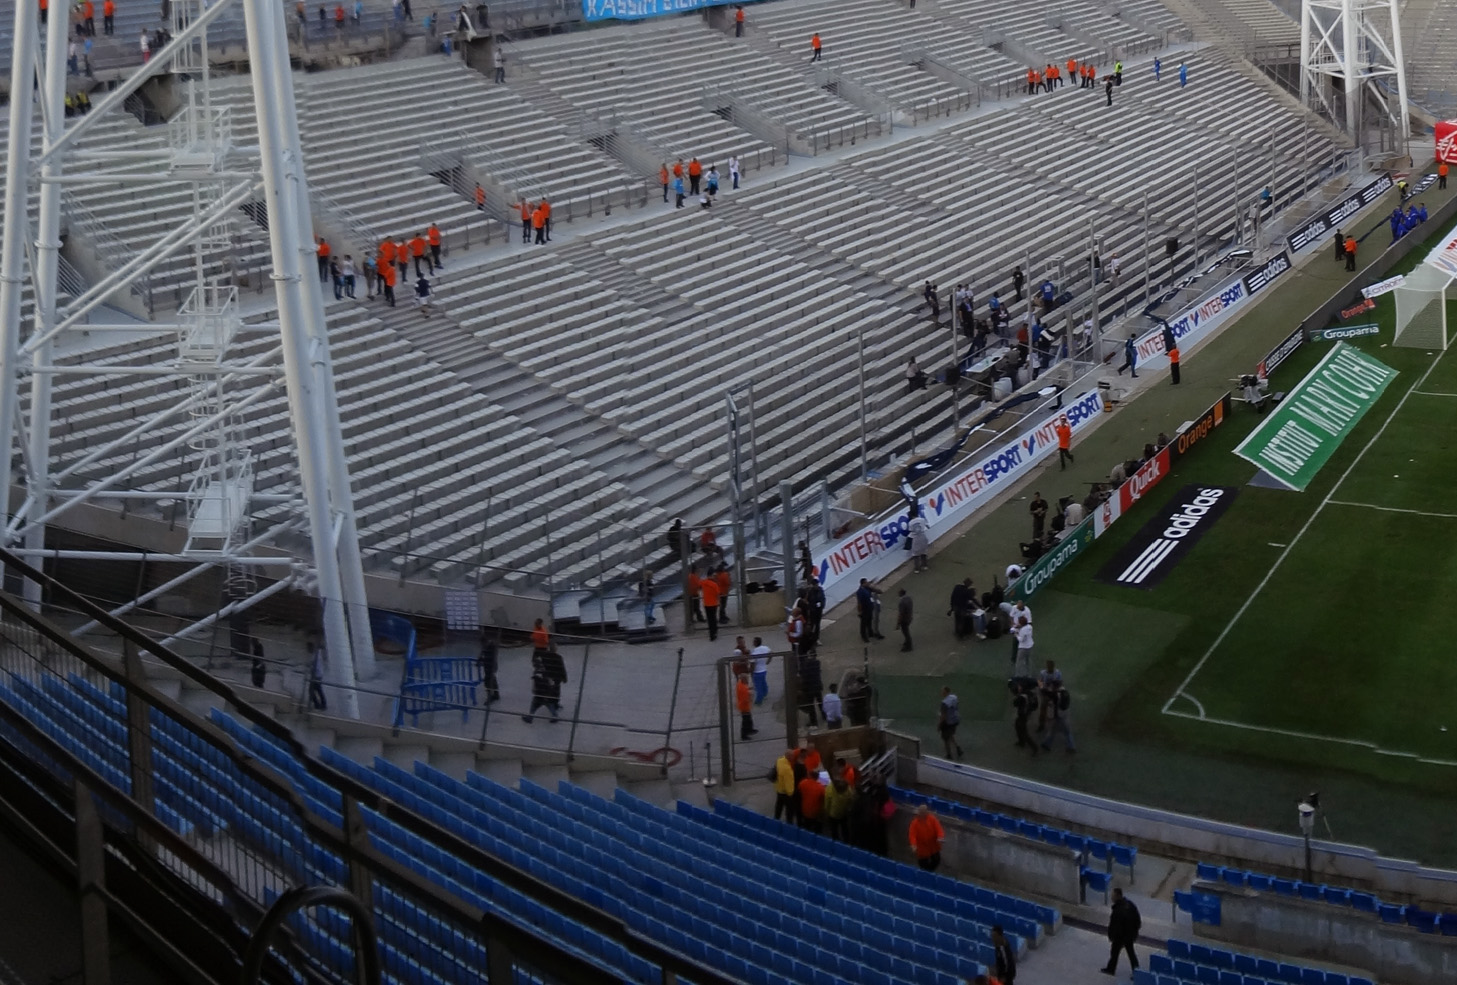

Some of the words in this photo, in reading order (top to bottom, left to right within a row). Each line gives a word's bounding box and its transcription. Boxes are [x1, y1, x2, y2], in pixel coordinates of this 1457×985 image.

[1340, 198, 1360, 218] adidas
[1305, 219, 1326, 241] adidas
[1262, 256, 1287, 281] adidas
[1199, 283, 1245, 323] INTERSPORT
[1323, 325, 1380, 340] Groupama
[1289, 378, 1361, 437] MARY
[1177, 415, 1214, 455] Orange
[1259, 420, 1323, 476] INSTITUT
[944, 445, 1023, 508] INTERSPORT
[1130, 459, 1160, 502] Quick
[1163, 488, 1225, 539] adidas
[1024, 538, 1078, 595] Groupama
